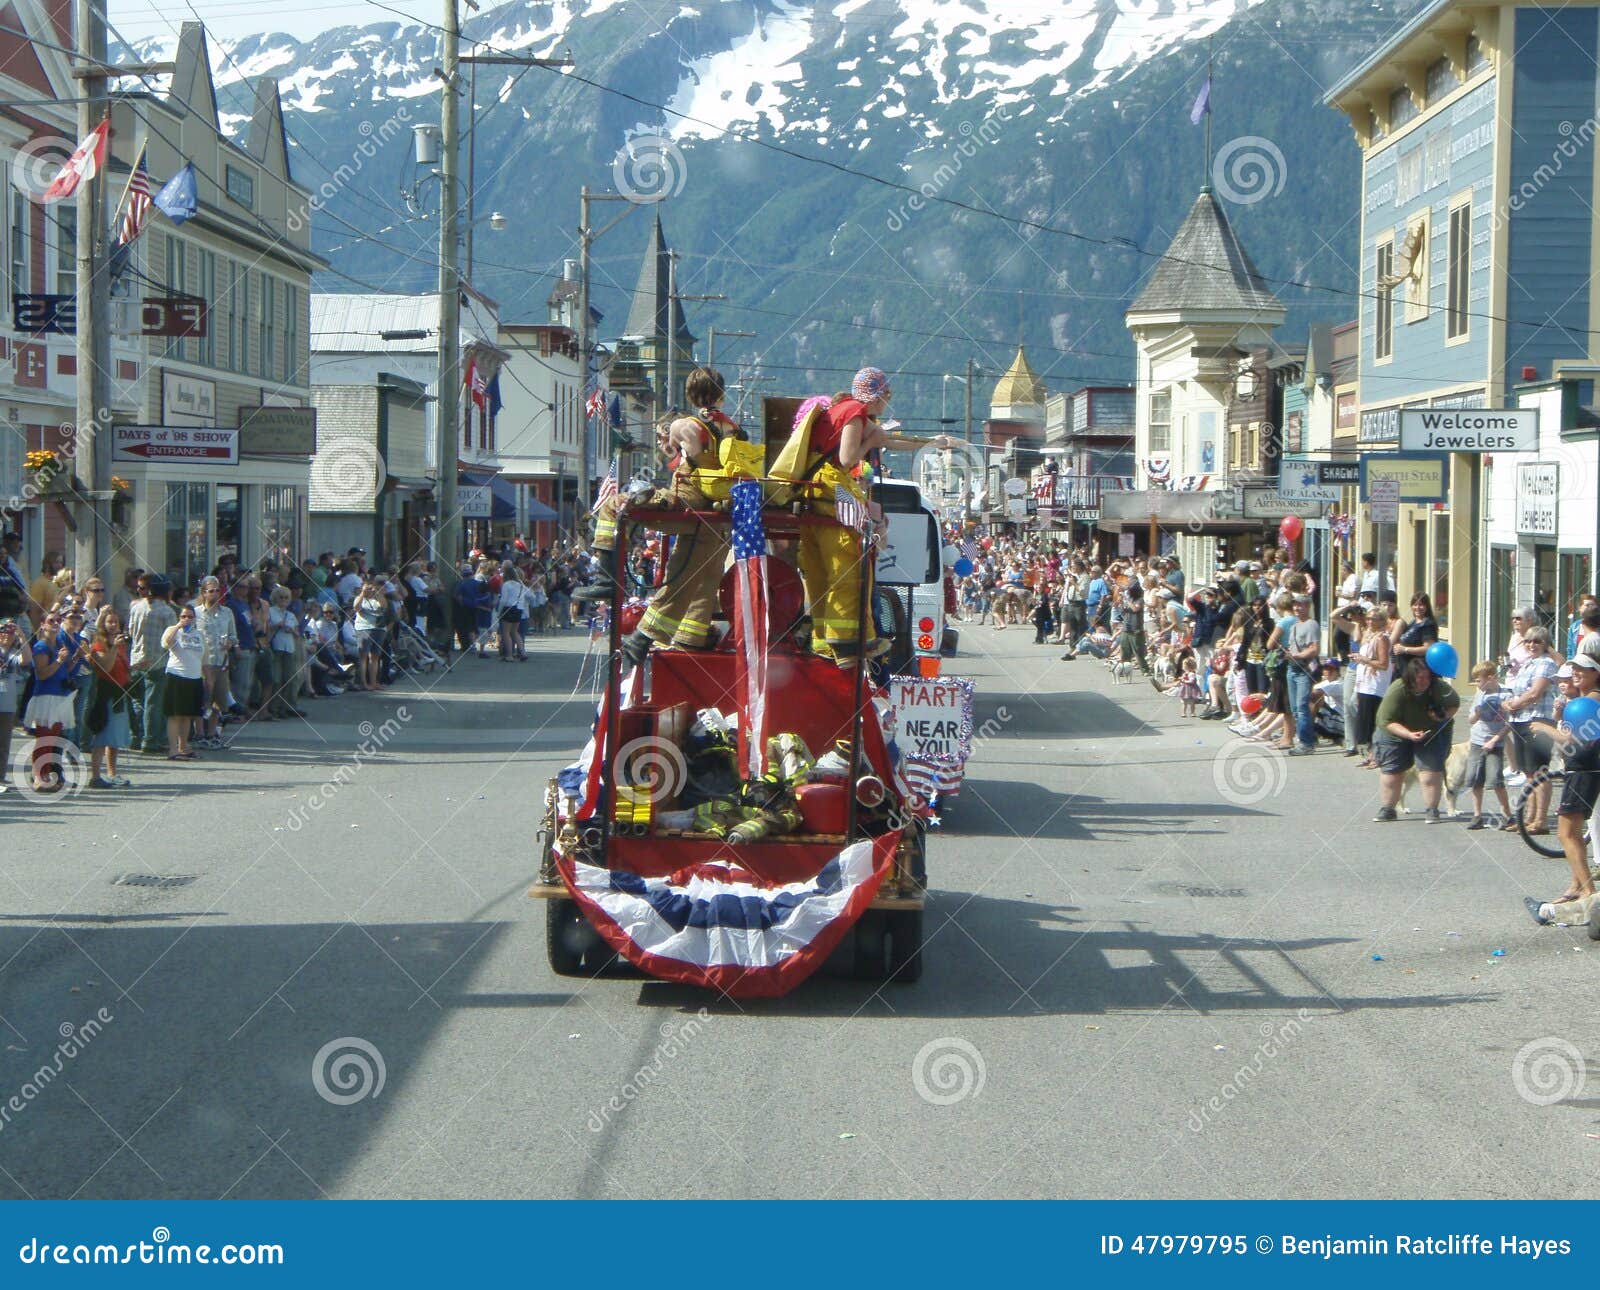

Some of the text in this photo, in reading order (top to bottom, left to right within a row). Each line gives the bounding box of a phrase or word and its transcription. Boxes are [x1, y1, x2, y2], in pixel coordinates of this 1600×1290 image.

[1422, 413, 1518, 429] Welcome
[118, 429, 150, 440] DAYS
[156, 431, 168, 441] of
[193, 431, 232, 443] SHOW
[1423, 432, 1516, 448] Jewelers
[146, 445, 208, 457] ENTRANCE
[1323, 467, 1359, 480] SKAGWA
[1282, 488, 1295, 498] OF
[1298, 489, 1336, 499] ALASKA
[901, 685, 960, 708] MART
[906, 720, 959, 740] NEAR
[915, 739, 950, 754] YOU
